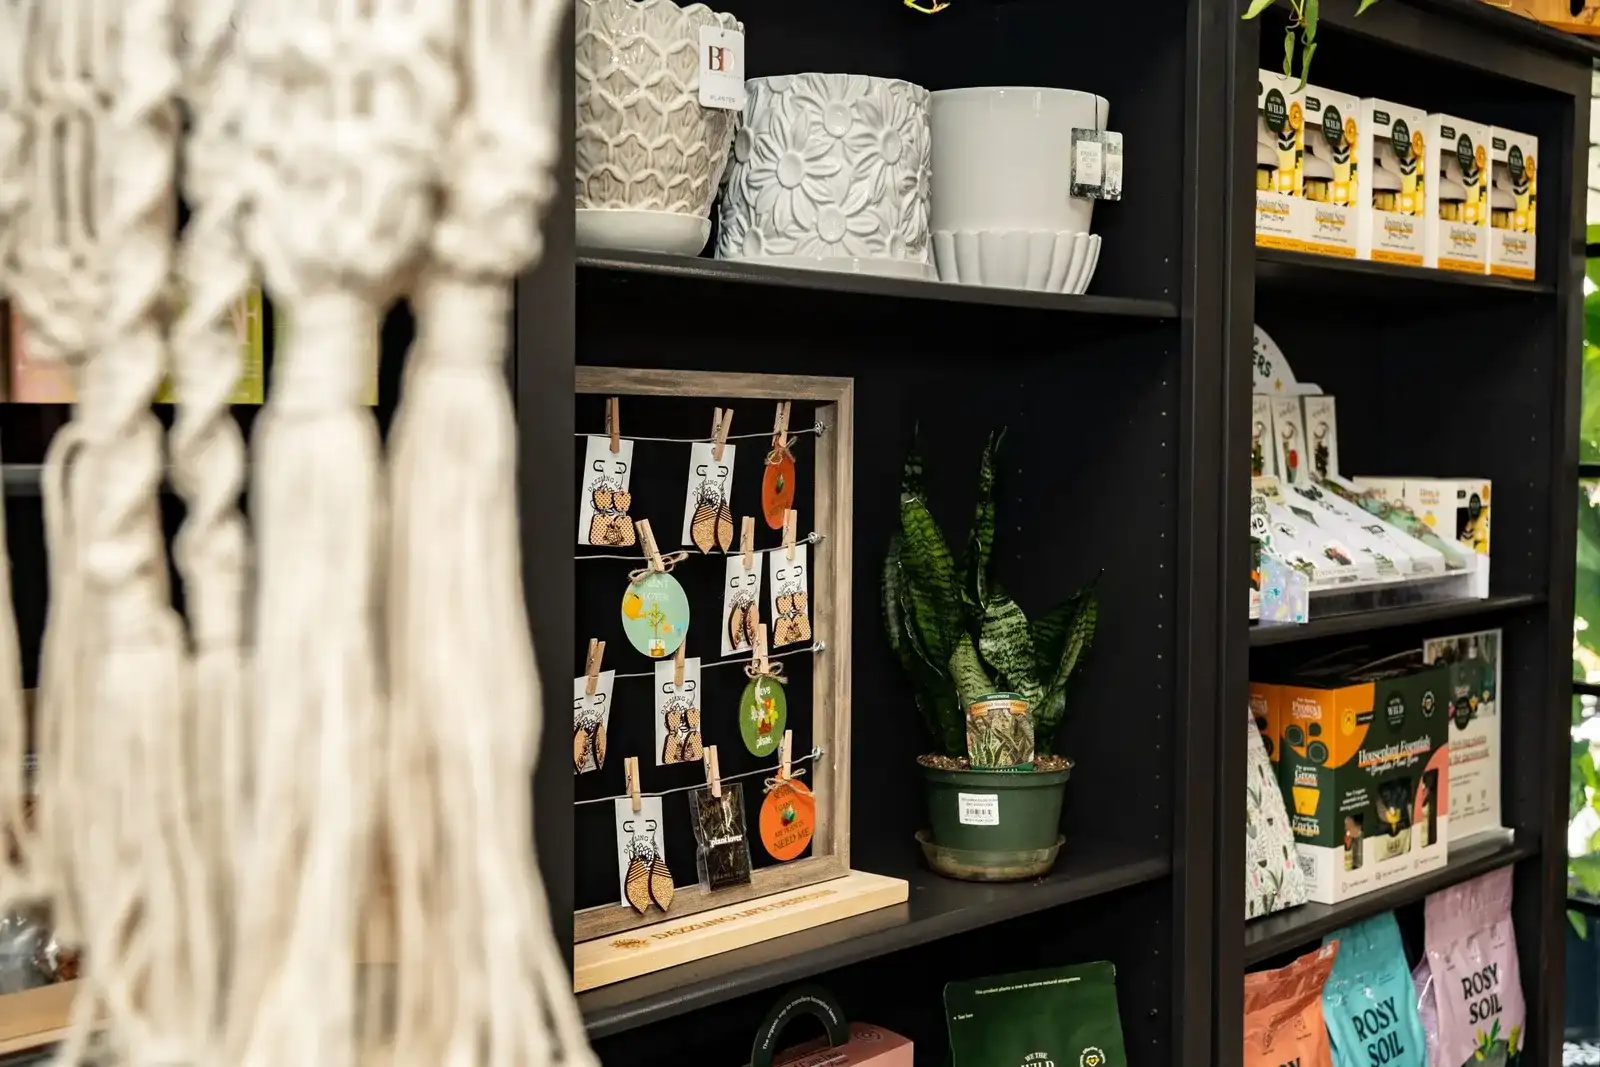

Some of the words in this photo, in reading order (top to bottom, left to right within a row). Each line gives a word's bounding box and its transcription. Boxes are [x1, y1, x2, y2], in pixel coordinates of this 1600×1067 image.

[1267, 102, 1284, 114] WILD
[1325, 118, 1341, 130] WILD
[1387, 704, 1404, 716] WILD
[1358, 743, 1400, 766] Houseplant
[773, 833, 797, 851] NEED
[797, 827, 810, 840] ME
[652, 916, 736, 940] DAZZLING
[1461, 962, 1499, 1000] ROSY
[1351, 996, 1399, 1042] ROSY
[1469, 993, 1502, 1025] SOIL
[1025, 1053, 1034, 1061] WE
[1035, 1052, 1048, 1060] THE
[1367, 1031, 1404, 1067] SOIL
